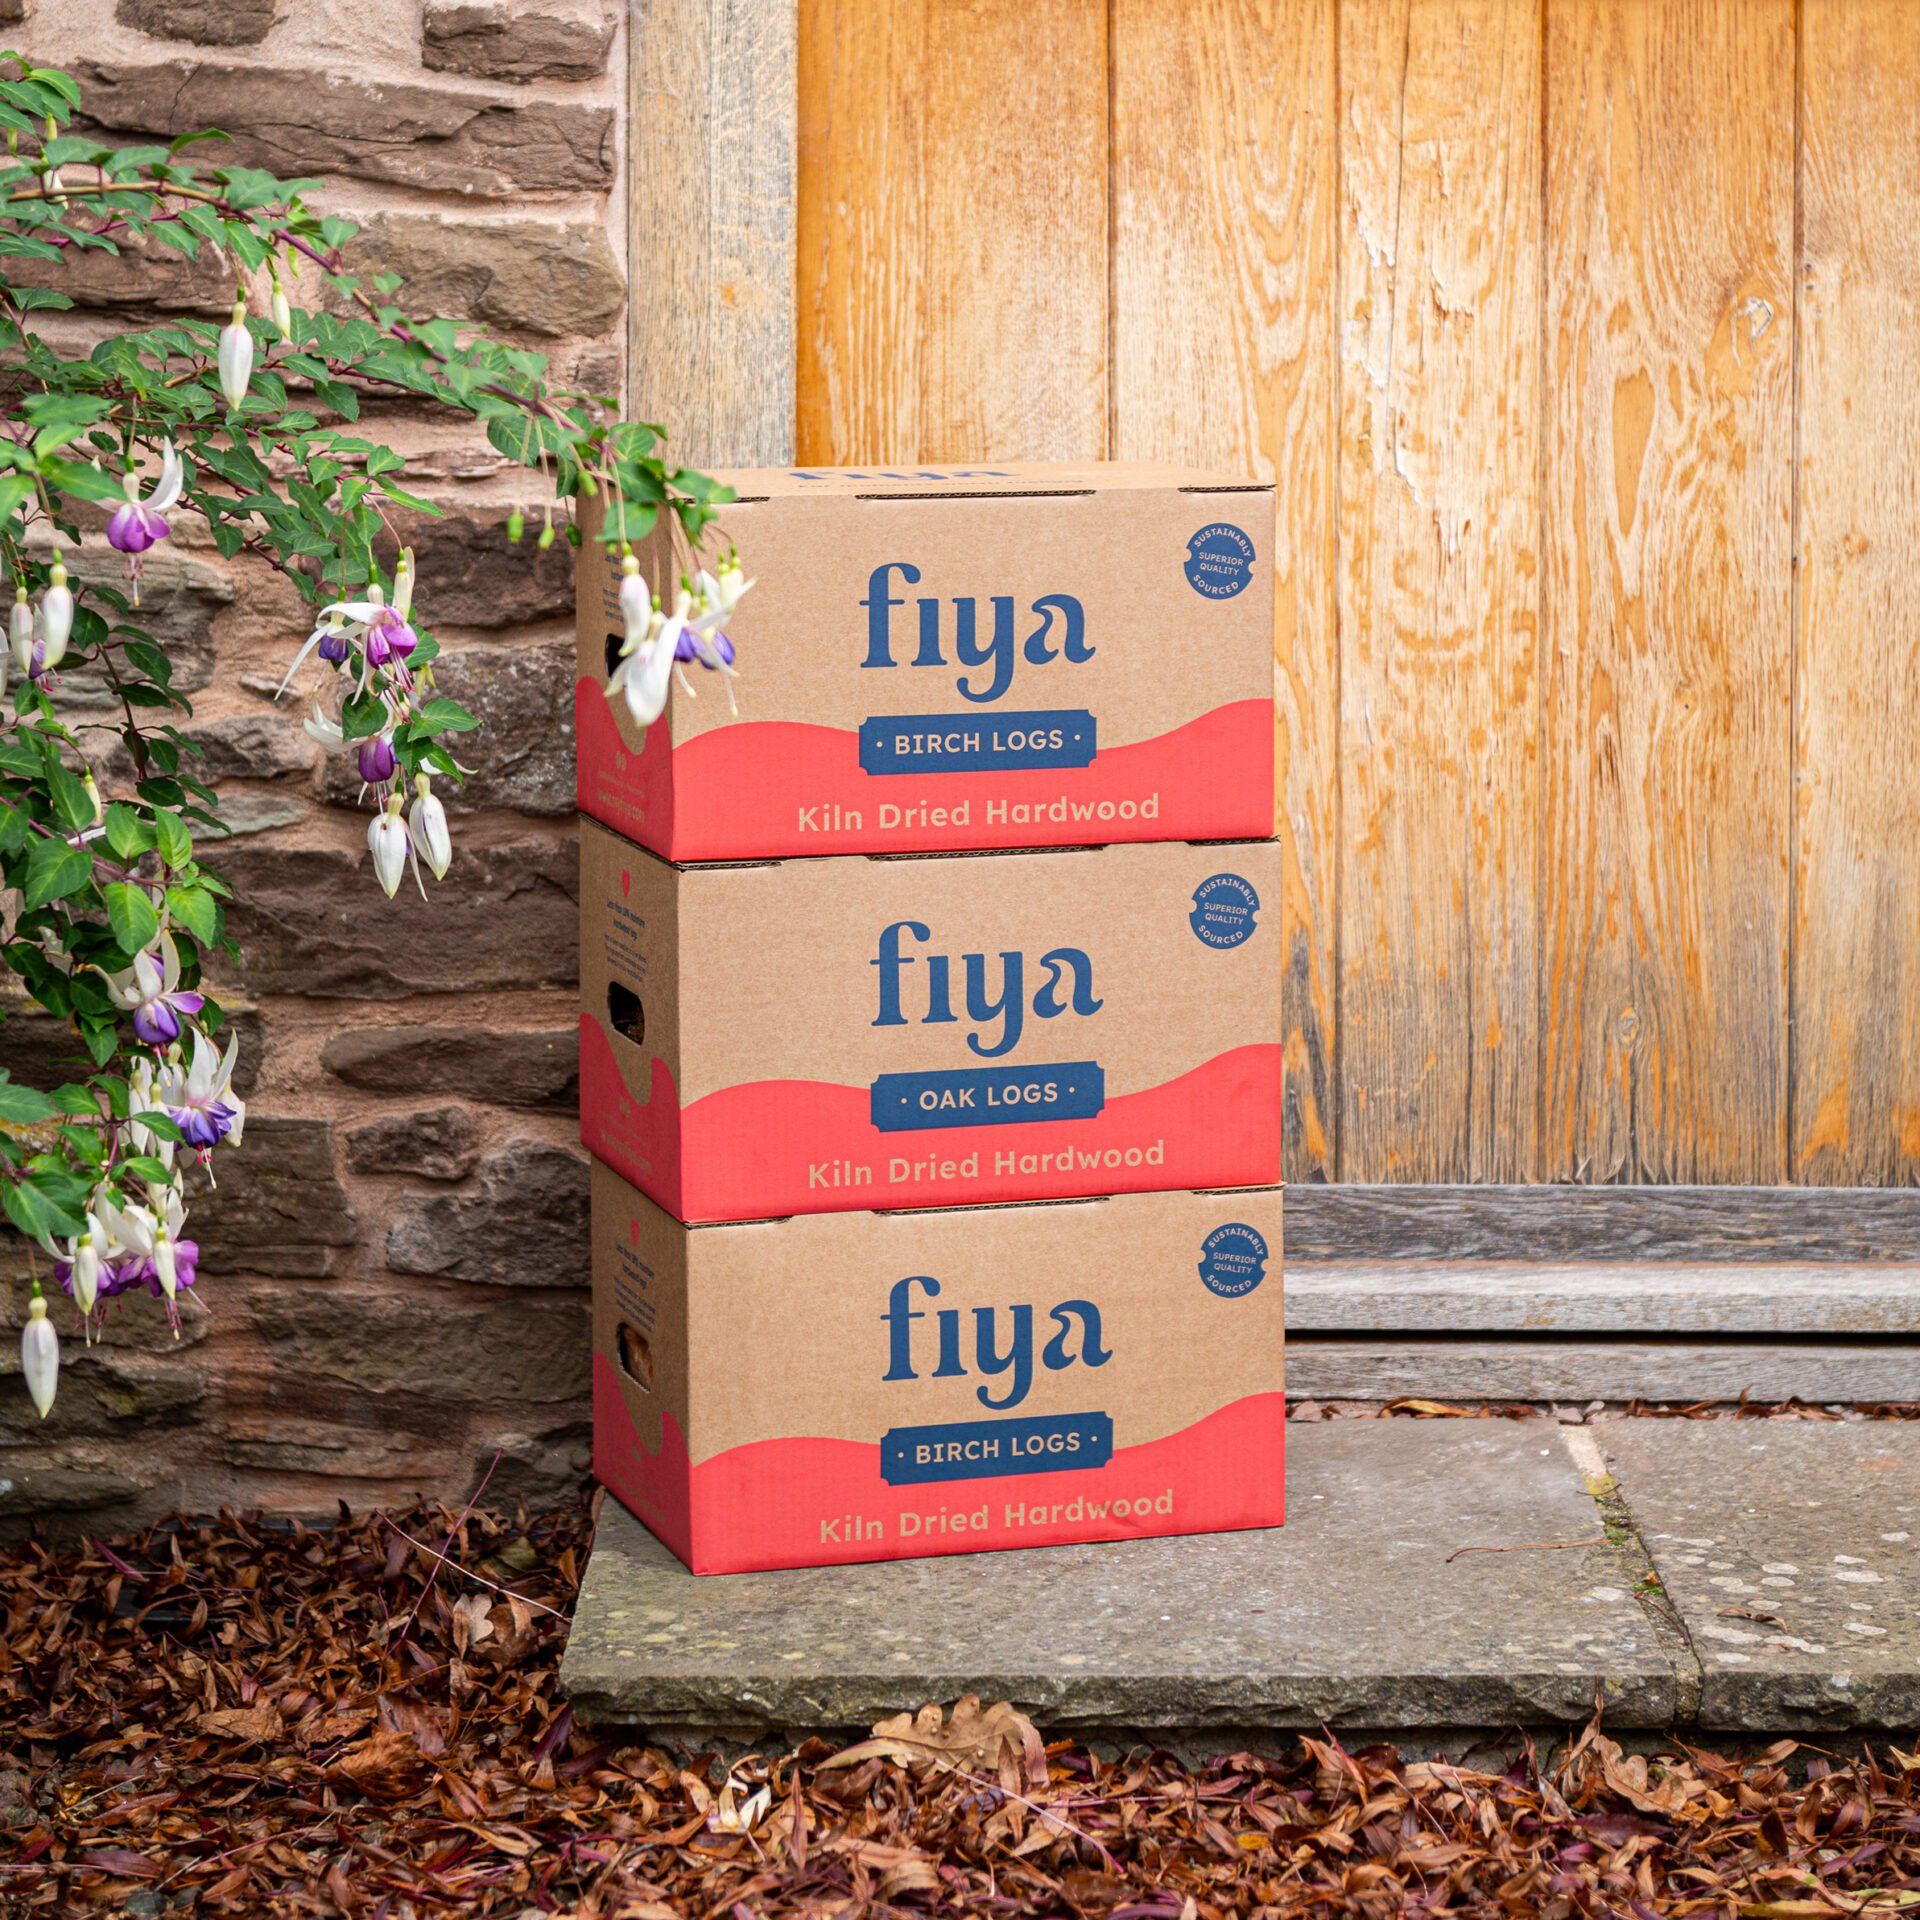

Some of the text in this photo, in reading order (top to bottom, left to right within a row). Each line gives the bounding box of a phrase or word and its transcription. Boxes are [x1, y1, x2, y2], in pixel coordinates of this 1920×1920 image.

[1194, 528, 1251, 557] SUSTAINABLY
[1199, 552, 1244, 566] SUPERIOR
[1200, 563, 1240, 576] QUALITY
[1193, 574, 1239, 595] SOURCED
[860, 562, 1096, 703] fiya
[895, 729, 1063, 755] BIRCH LOGS
[798, 792, 1160, 833] Kiln Dried Hardwood
[1199, 878, 1256, 907] SUSTAINABLY
[1204, 902, 1248, 916] SUPERIOR
[1205, 913, 1244, 926] QUALITY
[1198, 924, 1244, 944] SOURCED
[870, 921, 1104, 1058] fiya
[919, 1082, 1058, 1111] OAK LOGS
[808, 1139, 1165, 1189] Kiln Dried Hardwood
[1208, 1227, 1265, 1256] SUSTAINABLY
[1213, 1252, 1257, 1265] SUPERIOR
[1214, 1262, 1253, 1275] QUALITY
[1207, 1274, 1252, 1293] SOURCED
[880, 1275, 1113, 1411] fiya
[915, 1431, 1082, 1465] BIRCH LOGS
[820, 1488, 1175, 1544] Kiln Dried Hardwood
